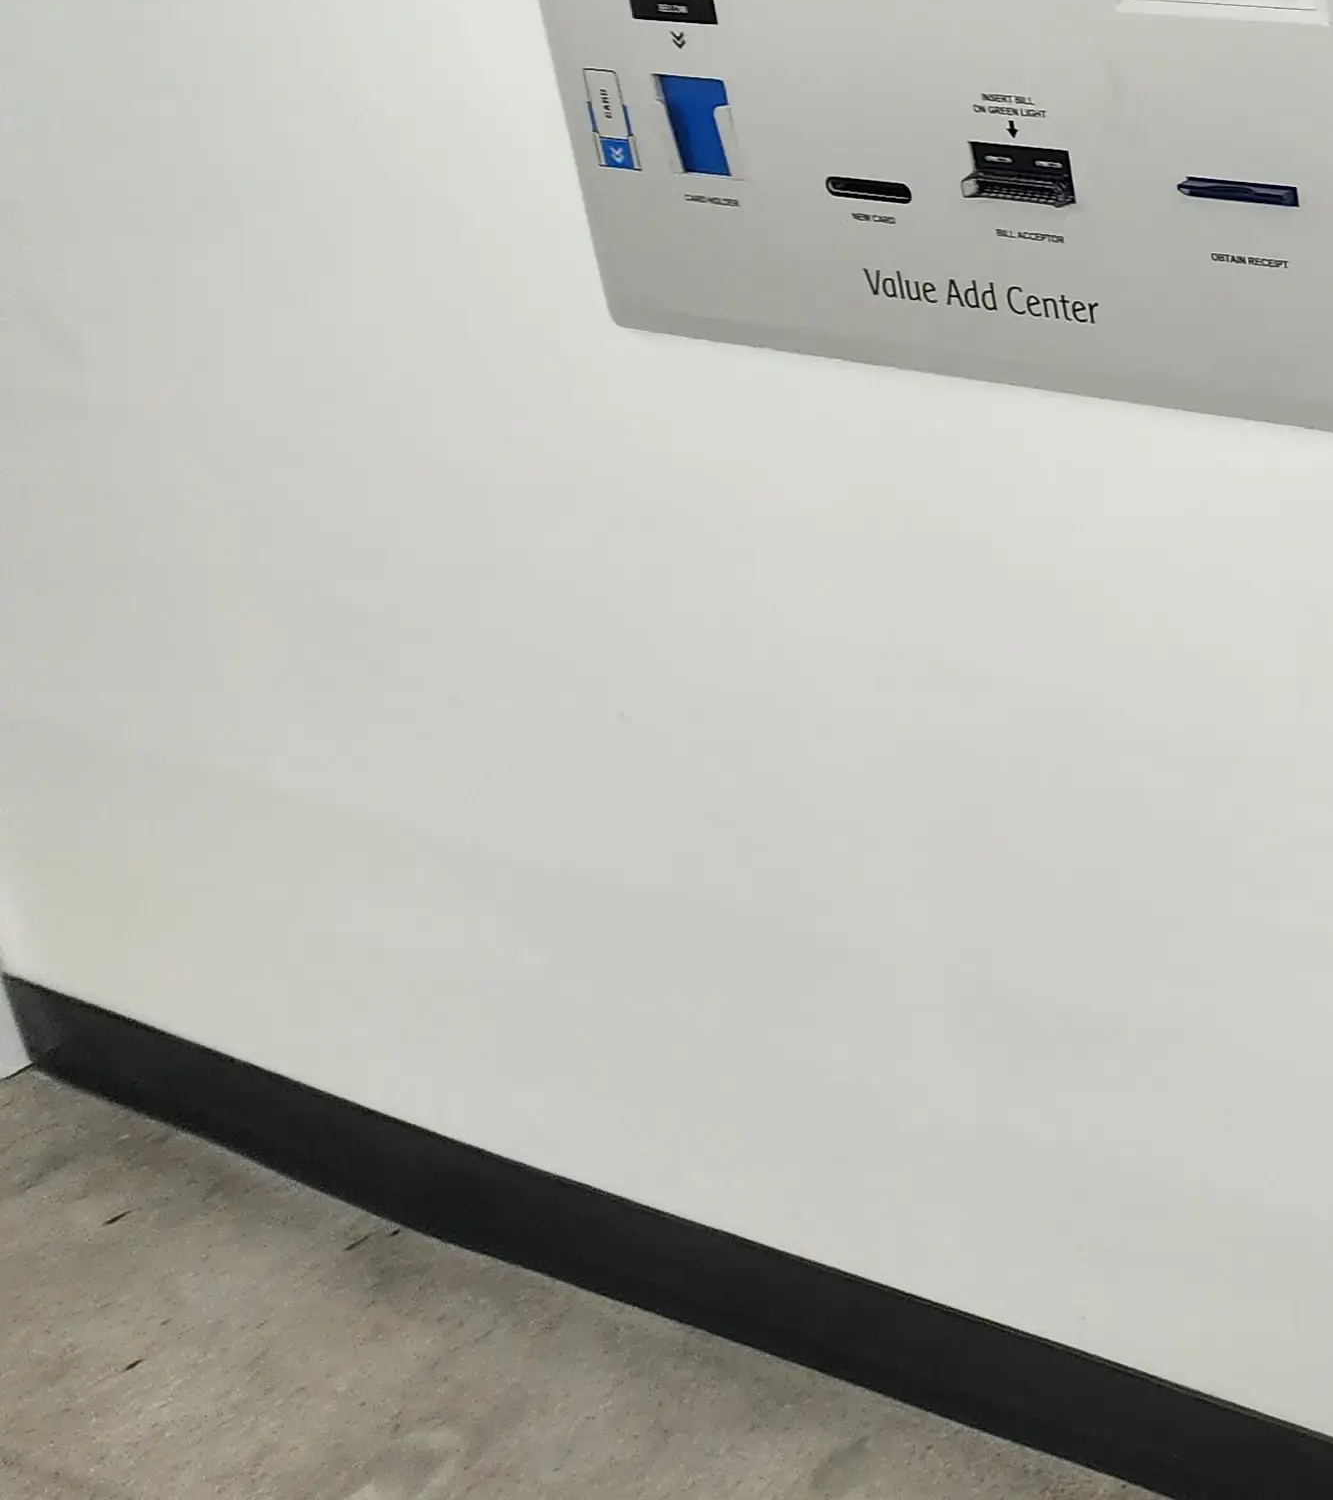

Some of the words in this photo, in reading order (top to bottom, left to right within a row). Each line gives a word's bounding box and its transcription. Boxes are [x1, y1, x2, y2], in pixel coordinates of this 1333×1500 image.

[1247, 257, 1289, 268] RECEIPT
[863, 268, 938, 303] Value
[946, 279, 998, 311] Add
[1006, 286, 1099, 324] Center
